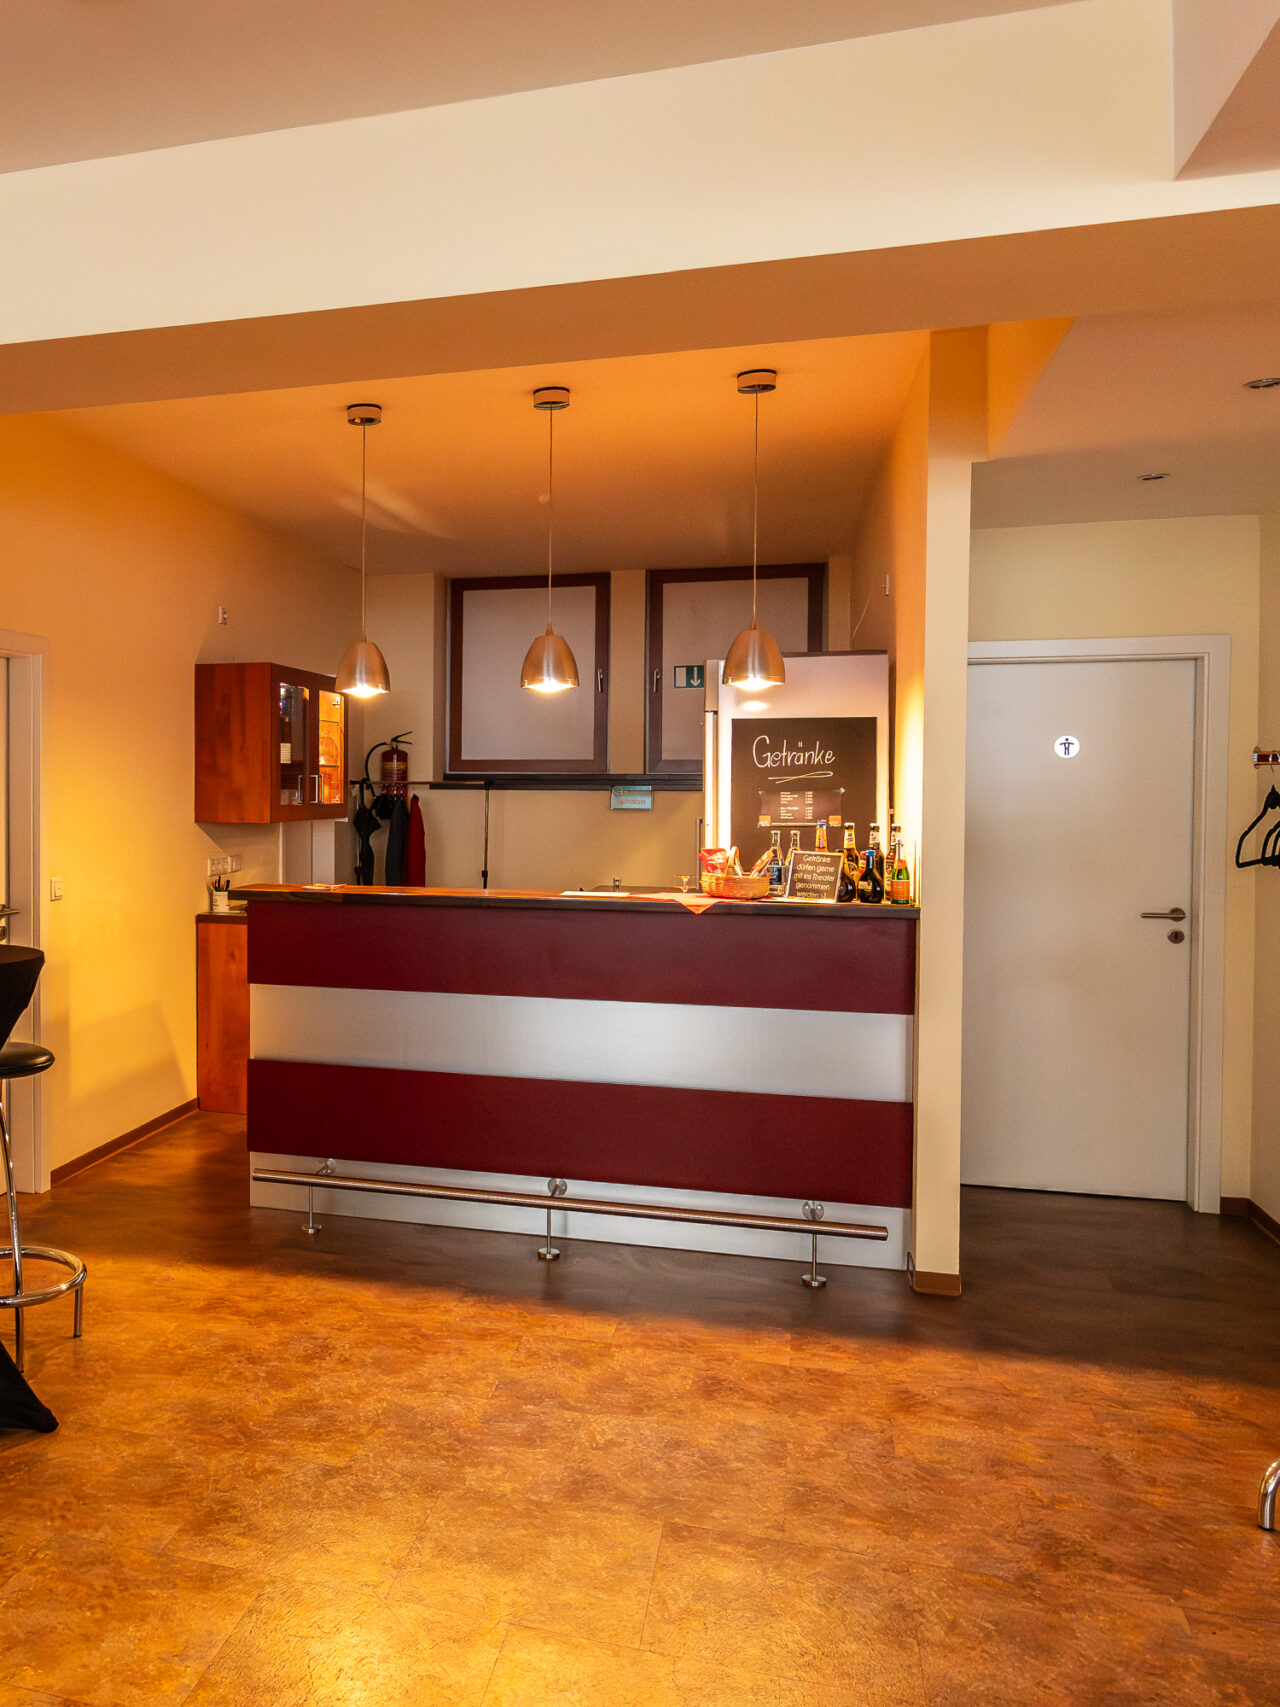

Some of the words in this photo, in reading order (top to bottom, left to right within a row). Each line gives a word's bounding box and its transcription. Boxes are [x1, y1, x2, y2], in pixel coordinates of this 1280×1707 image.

[753, 735, 835, 768] Getränke
[803, 854, 831, 863] Getränke
[796, 863, 816, 871] dürfen
[816, 865, 835, 873] gerne
[794, 872, 803, 880] mit
[812, 873, 835, 882] Theater
[795, 882, 830, 890] genommen
